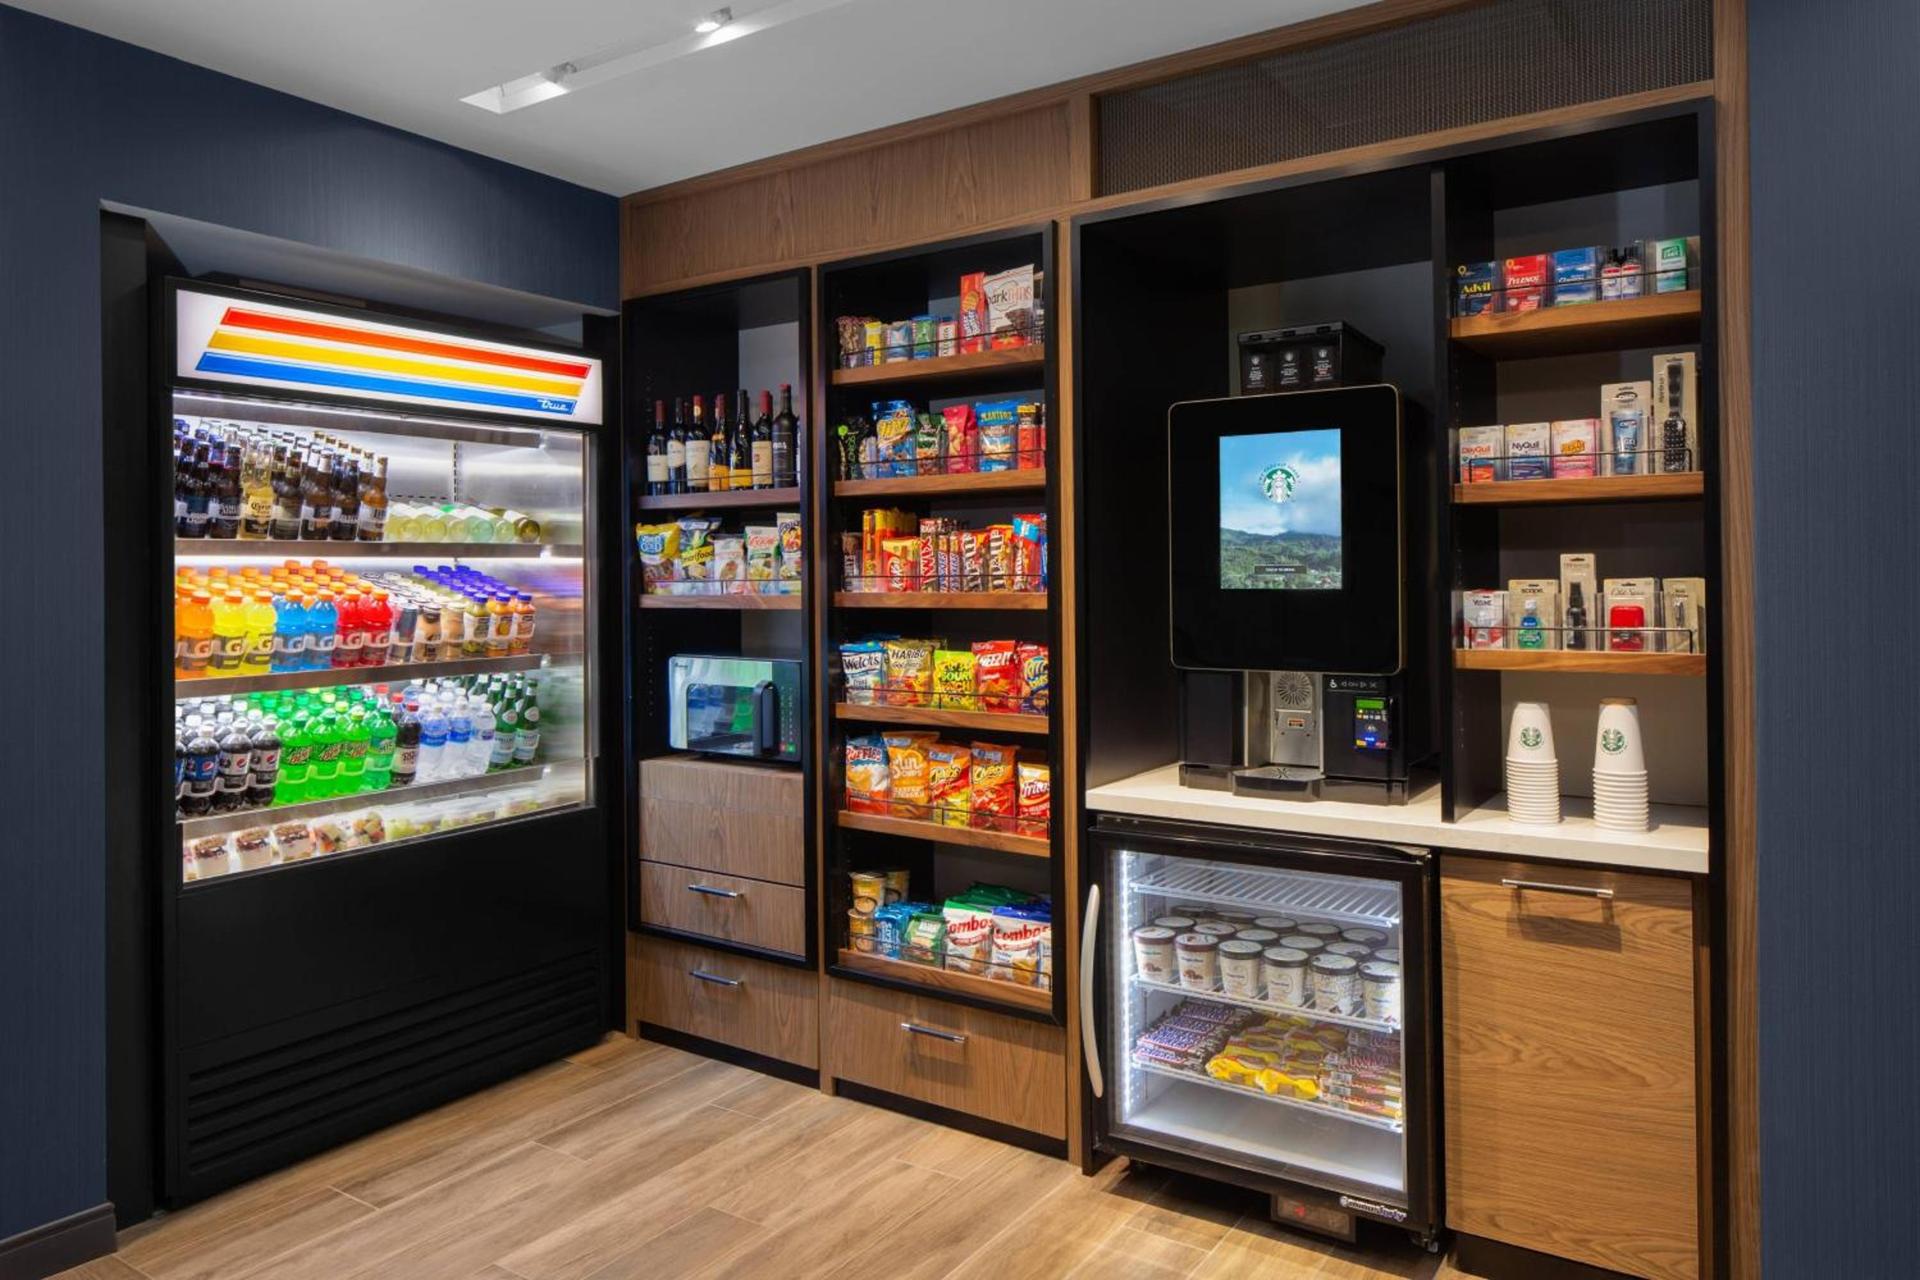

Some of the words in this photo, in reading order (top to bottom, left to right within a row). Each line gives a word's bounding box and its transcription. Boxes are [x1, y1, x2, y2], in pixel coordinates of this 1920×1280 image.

[1461, 280, 1491, 294] Advil
[1461, 444, 1492, 456] DayQuil
[1512, 440, 1540, 452] NyQuil
[890, 648, 926, 660] HARIBO
